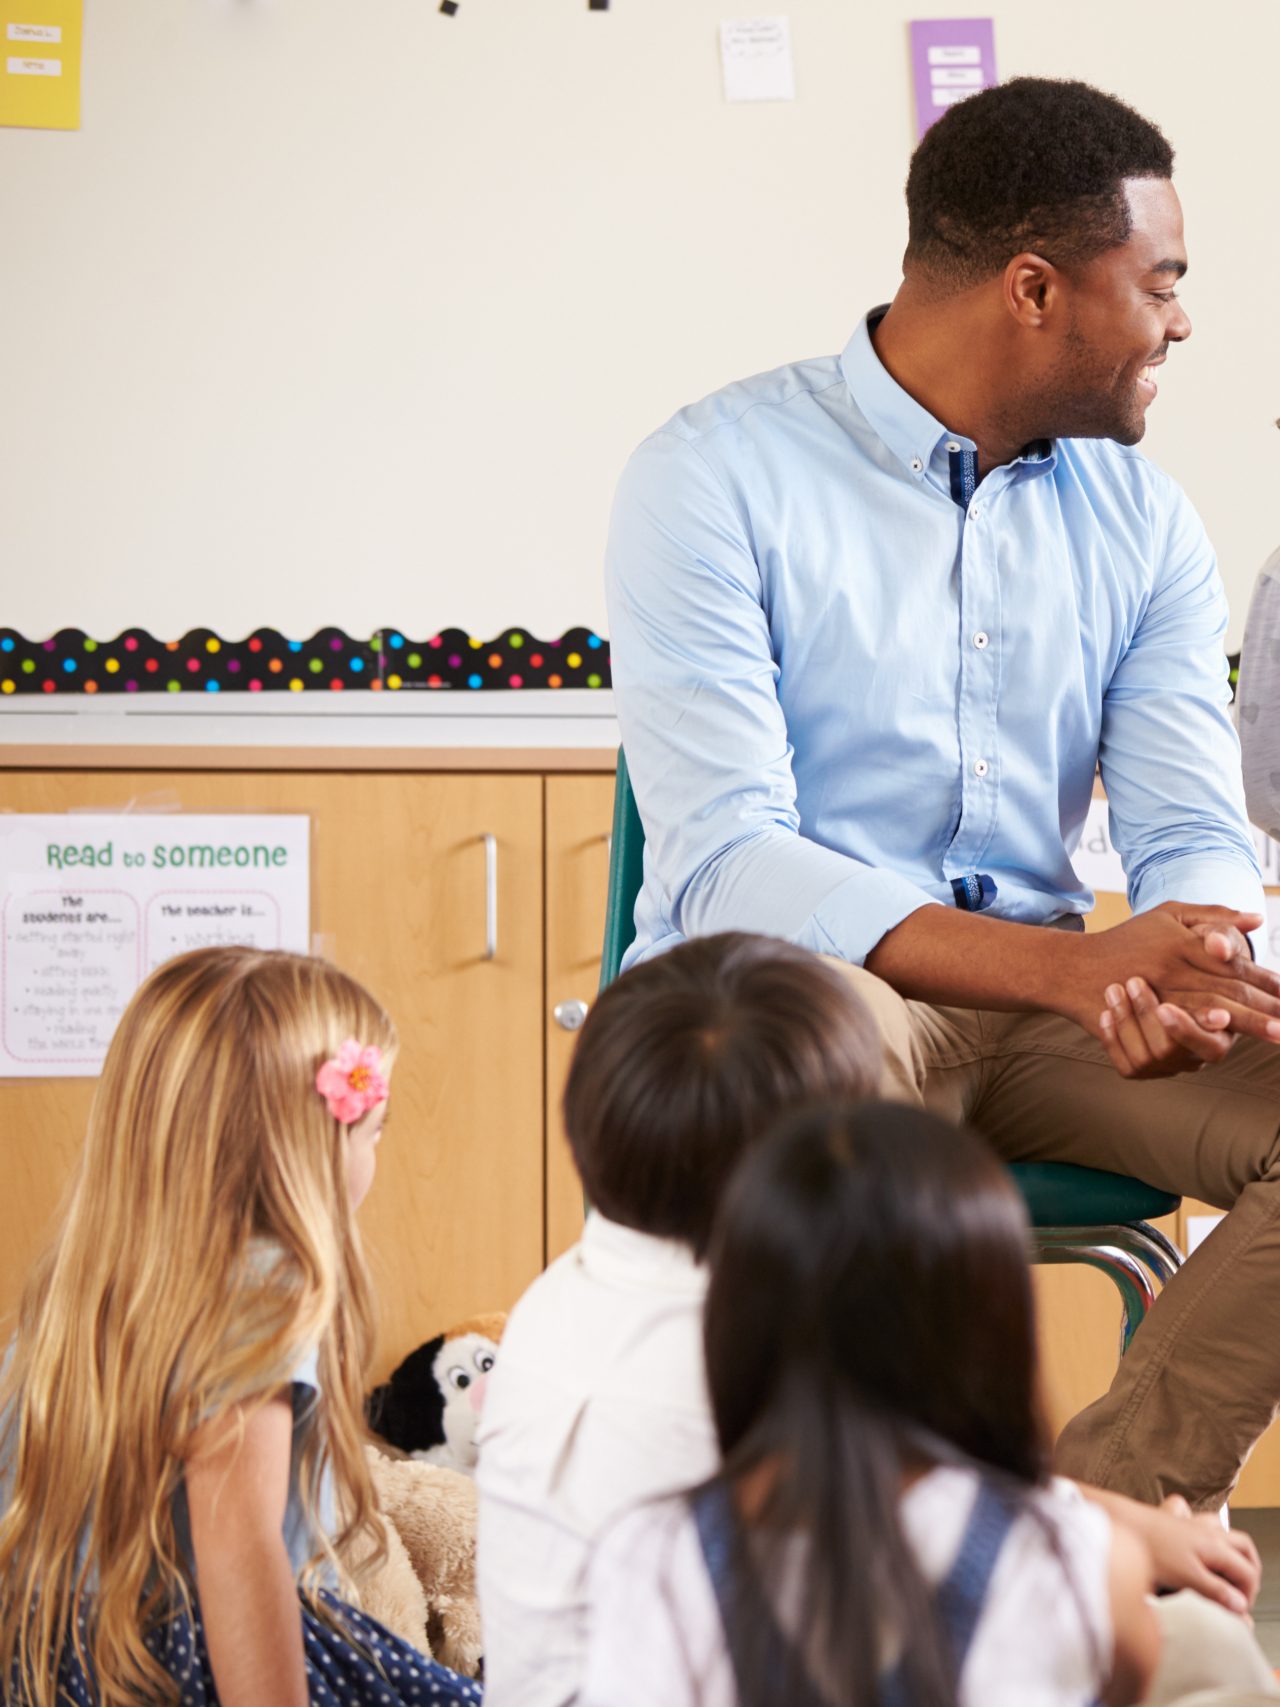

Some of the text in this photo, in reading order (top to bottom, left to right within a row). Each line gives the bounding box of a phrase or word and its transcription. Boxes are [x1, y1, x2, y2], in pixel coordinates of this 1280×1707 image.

[46, 841, 288, 869] Read to someone
